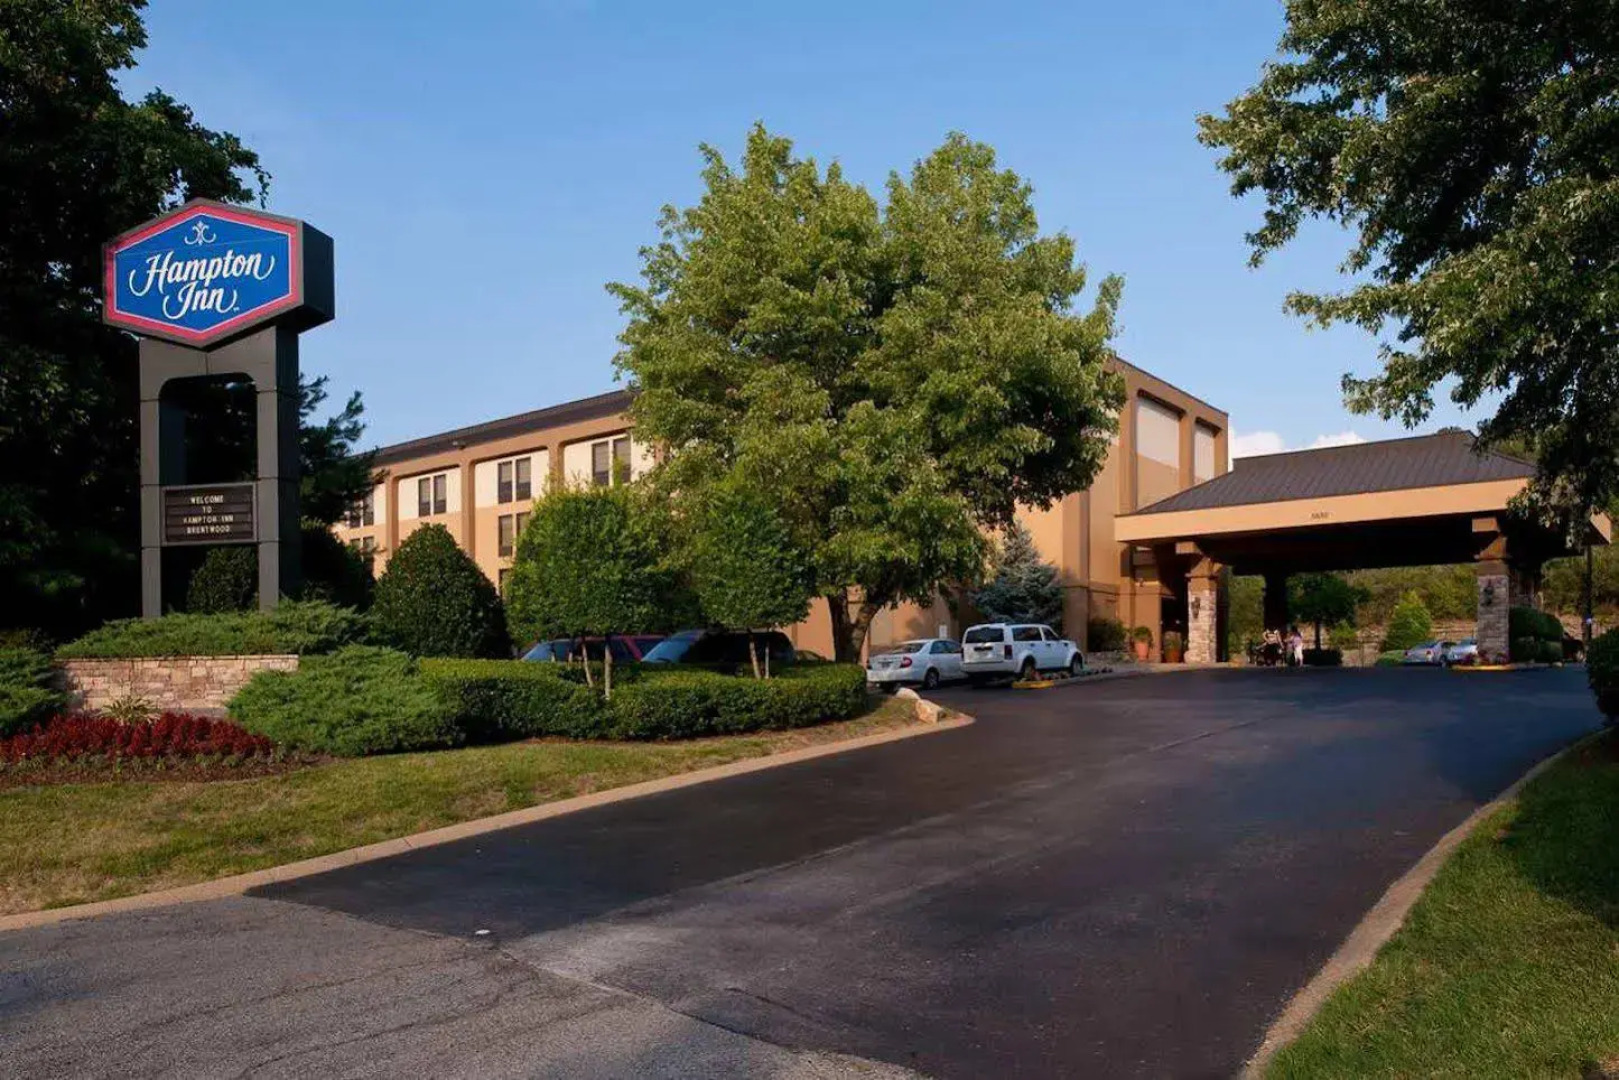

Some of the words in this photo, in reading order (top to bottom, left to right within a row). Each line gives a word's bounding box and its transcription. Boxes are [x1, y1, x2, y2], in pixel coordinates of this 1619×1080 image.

[129, 250, 275, 297] Hampton
[162, 281, 237, 320] Inn
[190, 495, 224, 504] WELCOME
[202, 506, 212, 514] TO
